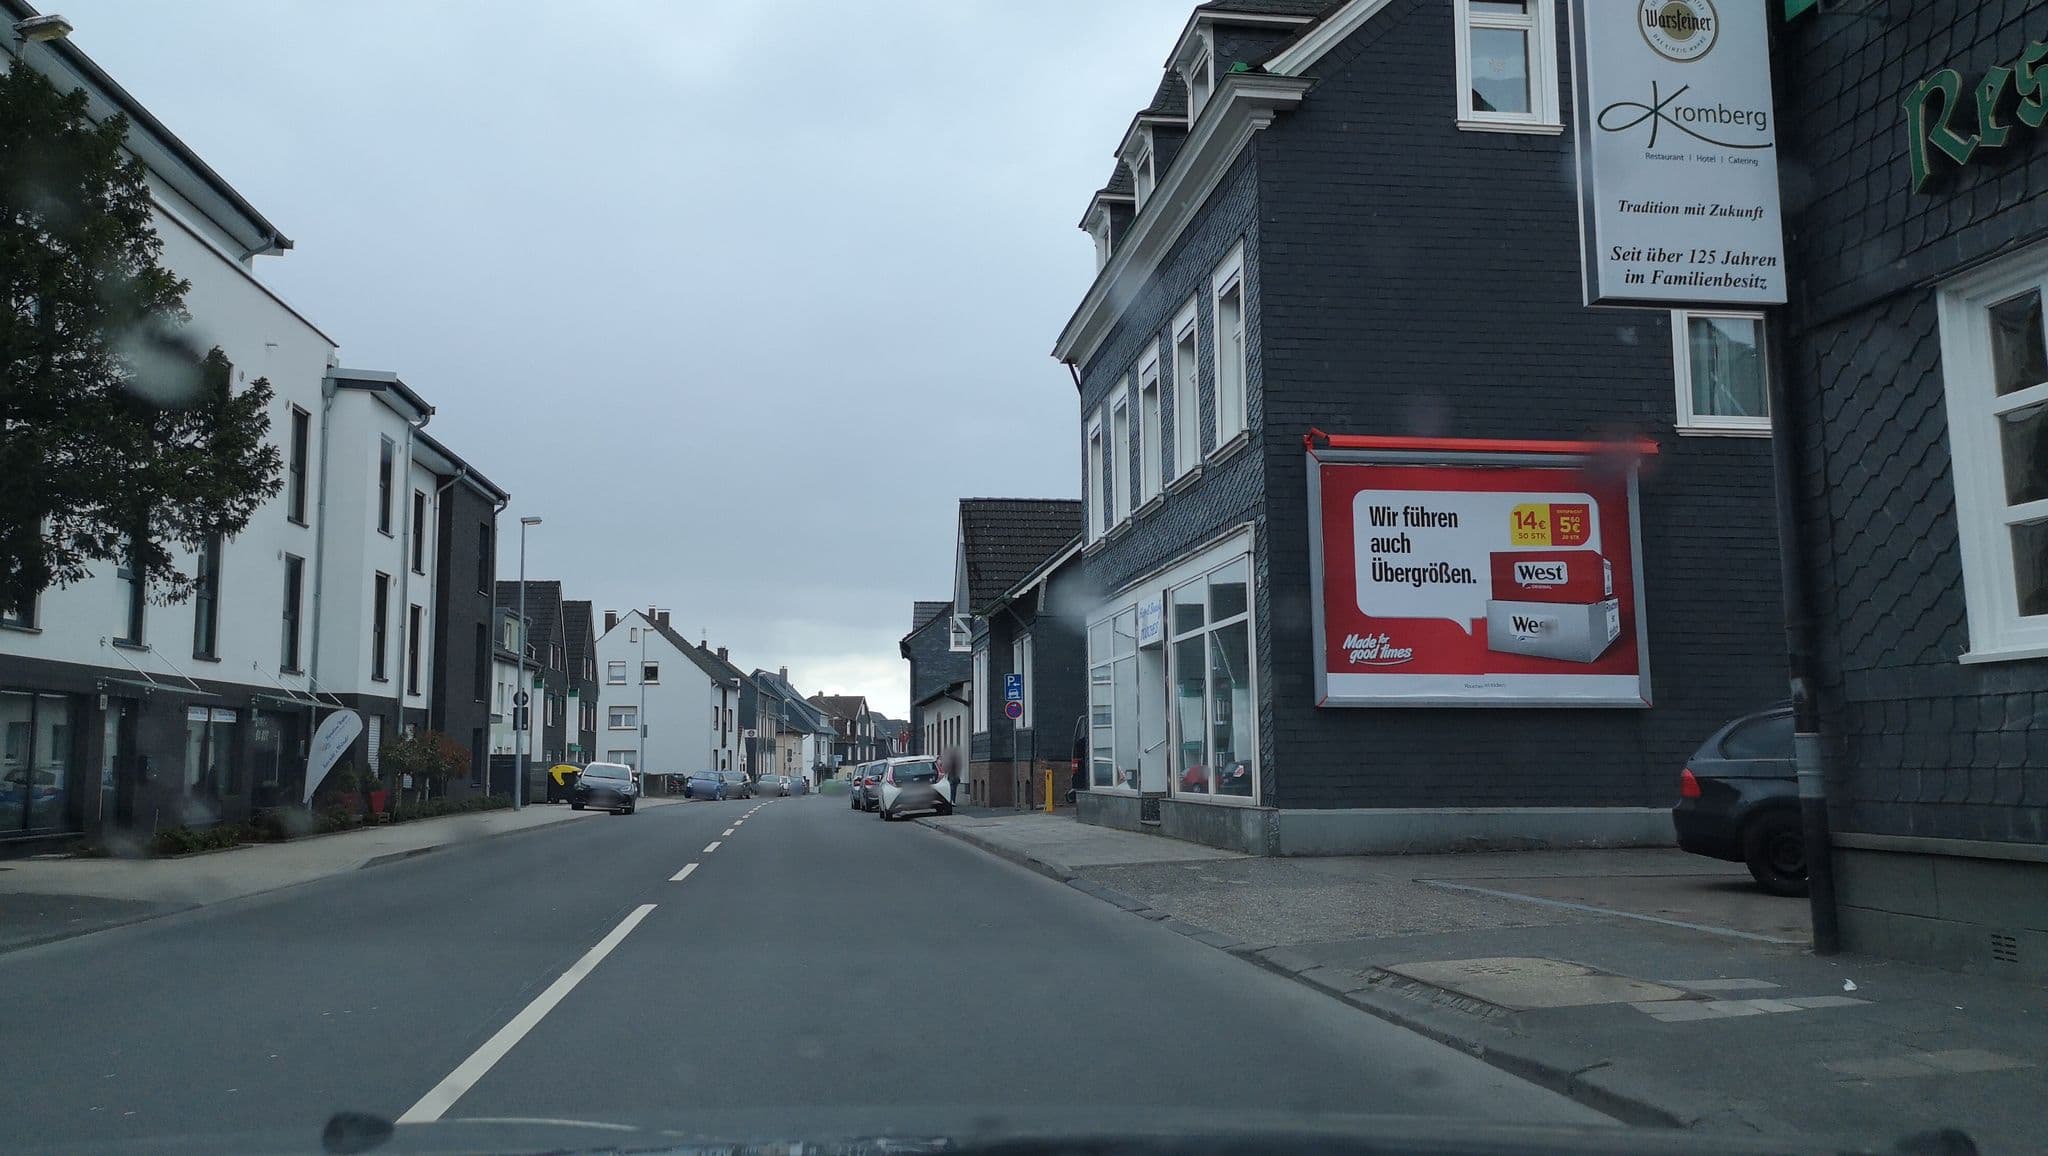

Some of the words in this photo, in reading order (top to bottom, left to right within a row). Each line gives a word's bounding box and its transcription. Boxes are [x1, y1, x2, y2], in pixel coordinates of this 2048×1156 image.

[1645, 8, 1712, 31] Warsteiner
[1597, 80, 1773, 148] Kromberg
[1645, 152, 1684, 161] Restaurant
[1696, 155, 1716, 163] Hotel
[1728, 156, 1759, 167] Catering
[1618, 200, 1680, 214] Tradition
[1684, 203, 1705, 216] mit
[1709, 203, 1764, 221] Zukunft
[1610, 245, 1642, 262] Seit
[1646, 247, 1683, 263] über
[1688, 250, 1716, 265] 125
[1720, 250, 1777, 267] Jahren
[1624, 269, 1644, 284] im
[1651, 270, 1768, 290] Familienbesitz
[1369, 506, 1399, 527] Wir
[1402, 506, 1458, 528] führen
[1370, 532, 1411, 553] auch
[1518, 532, 1529, 540] 50
[1531, 532, 1546, 540] STK
[1371, 557, 1477, 588] Übergrößen.
[1518, 565, 1564, 581] West
[1342, 633, 1377, 650] Made
[1378, 633, 1390, 644] for
[1349, 644, 1379, 664] good
[1007, 676, 1015, 686] P
